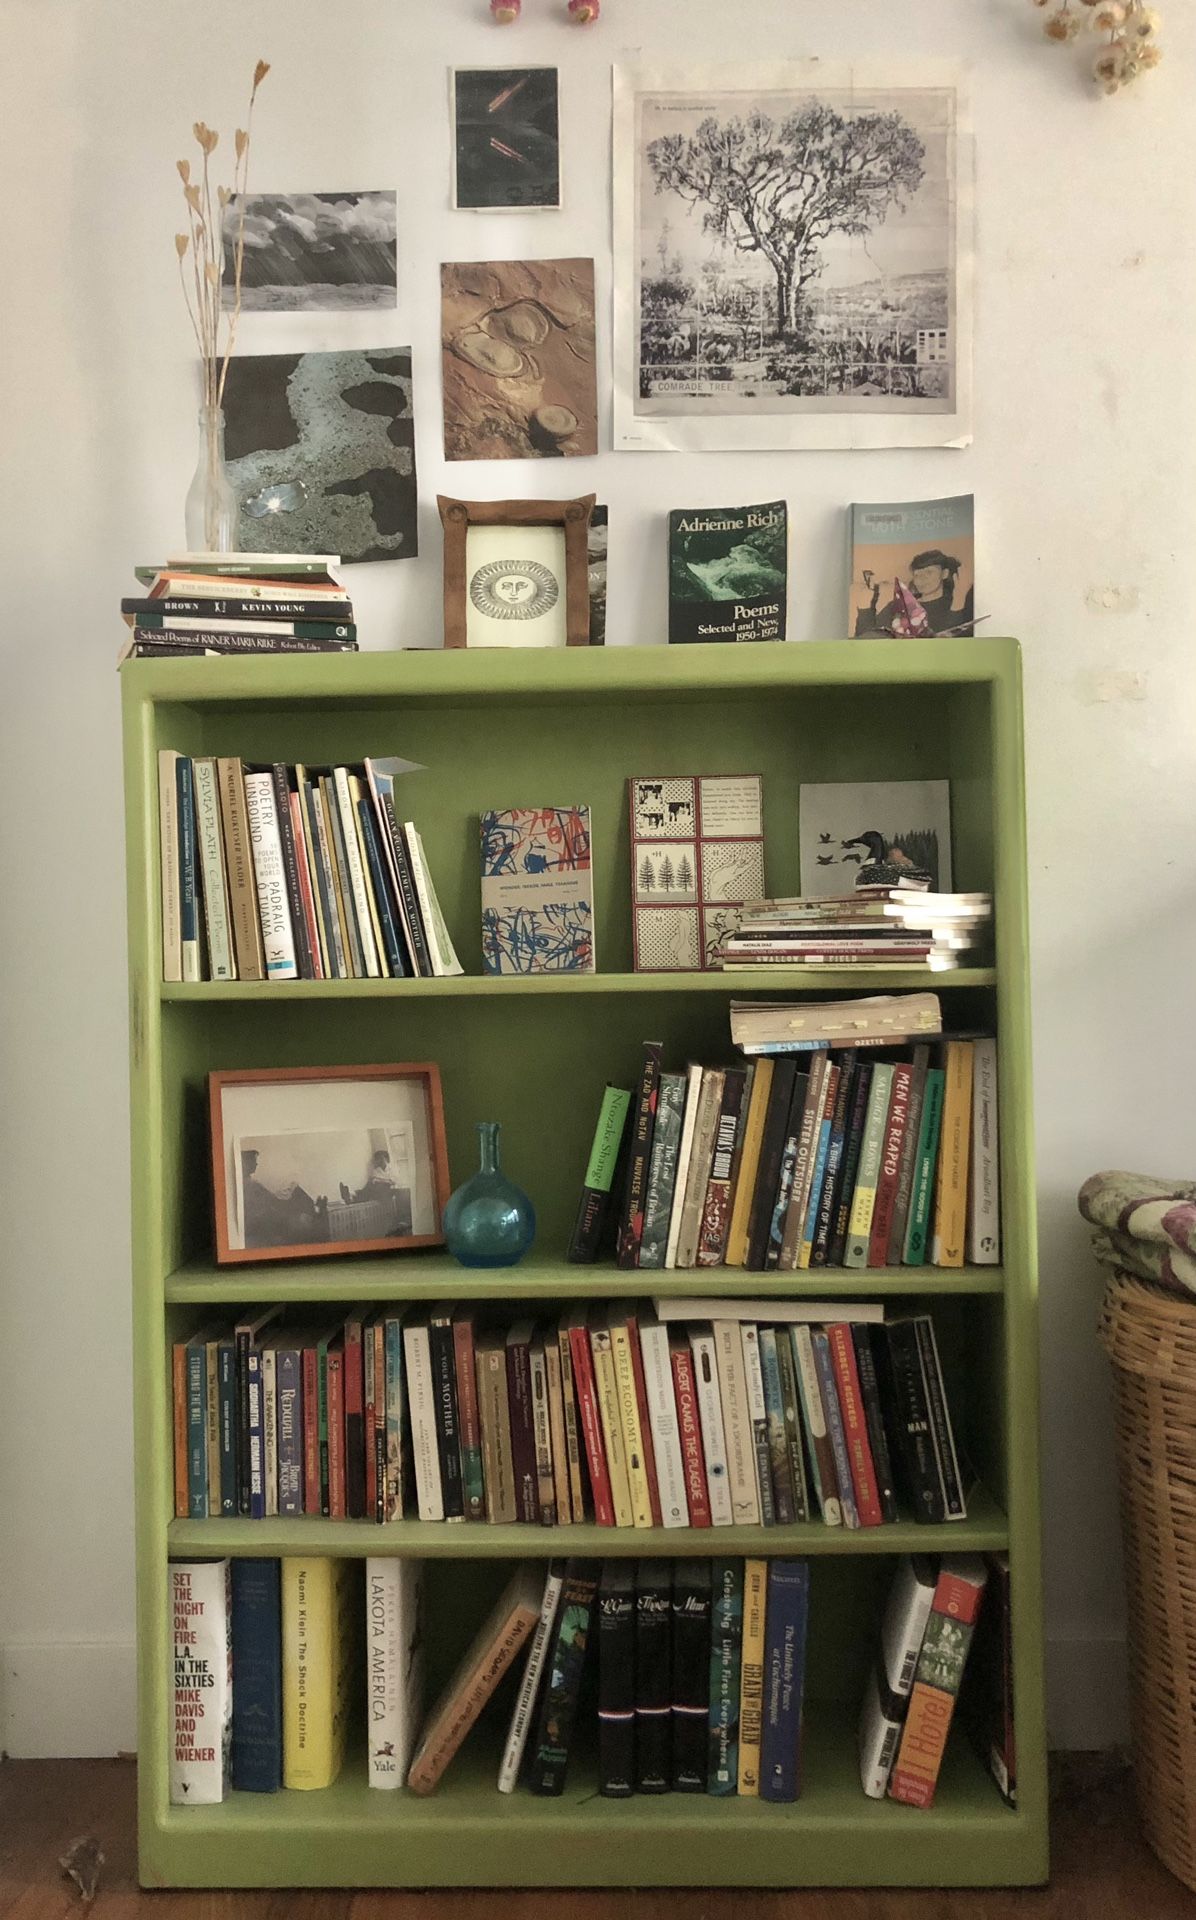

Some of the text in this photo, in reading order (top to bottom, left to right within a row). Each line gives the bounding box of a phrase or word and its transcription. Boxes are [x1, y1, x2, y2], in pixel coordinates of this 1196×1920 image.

[658, 383, 732, 391] COMRADE TREE
[677, 511, 777, 532] Adrienne Rich
[912, 517, 954, 529] STONE
[165, 602, 199, 610] BROWN
[242, 603, 305, 613] KEVIN YOUNG
[734, 603, 779, 620] Poems
[698, 621, 754, 634] Selected and
[140, 631, 167, 642] Selected
[201, 635, 231, 647] RAINER
[232, 637, 256, 648] MARIA
[257, 638, 276, 649] RILKE
[227, 775, 235, 807] MURIEL
[275, 767, 288, 813] GARY SOTO
[200, 767, 217, 860] SYLVIA PLATH
[246, 782, 262, 843] UNBOUND
[258, 781, 273, 826] POETRY
[228, 810, 241, 852] RUKEYSER
[386, 803, 404, 864] OCEAN VUONG
[235, 856, 244, 888] READER
[400, 870, 410, 889] TIME
[209, 870, 220, 917] Collected
[287, 858, 296, 890] SELECTED
[293, 894, 301, 916] POEMS
[406, 894, 413, 902] IS
[260, 895, 272, 938] TUAMA
[409, 913, 421, 948] MOTHER
[644, 1061, 653, 1074] THE
[982, 1056, 990, 1069] The
[642, 1080, 652, 1093] ZAD
[982, 1071, 991, 1087] End
[640, 1098, 650, 1112] AND
[671, 1087, 681, 1103] Guy
[982, 1090, 991, 1098] of
[658, 1086, 670, 1127] Shrubsole
[884, 1072, 910, 1176] MEN WE REAPED
[593, 1093, 624, 1185] Ntozake Shange
[713, 1115, 736, 1178] OCTAVIA'S BROOD
[662, 1144, 674, 1180] The Lost
[792, 1110, 814, 1202] SISTER OUTSIDER
[826, 1150, 837, 1174] BRIEF
[864, 1141, 880, 1176] BONES
[631, 1157, 644, 1195] MAUVAISE
[646, 1143, 664, 1227] Rainforests of Britain
[822, 1176, 835, 1210] HISTORY
[582, 1192, 601, 1233] Liliane
[820, 1212, 828, 1223] OF
[982, 1198, 991, 1214] Roy
[817, 1225, 827, 1244] TIME
[722, 1332, 731, 1354] RICH
[834, 1330, 848, 1382] ELIZABETH
[191, 1394, 200, 1405] THE
[249, 1383, 258, 1427] SIDDHARTHA
[265, 1391, 273, 1402] THE
[618, 1350, 636, 1444] DEEP ECONOMY
[728, 1383, 736, 1405] FACT
[191, 1408, 200, 1424] WALL
[281, 1389, 295, 1441] REDWALL
[442, 1383, 453, 1436] MOTHER
[731, 1408, 738, 1420] OF
[831, 1414, 837, 1424] OF
[676, 1354, 701, 1500] ALBERT CAMUS THE PLAGUE
[251, 1436, 260, 1494] HERMANN HESSE
[280, 1459, 291, 1498] JACQUES
[290, 1465, 301, 1491] BRIAN
[173, 1573, 191, 1586] SET
[299, 1571, 307, 1605] Naomi
[174, 1588, 192, 1600] THE
[720, 1570, 734, 1628] Celeste Ng
[174, 1602, 204, 1615] NIGHT
[174, 1617, 187, 1629] ON
[505, 1620, 526, 1646] DAVID
[175, 1632, 196, 1643] FIRE
[372, 1576, 385, 1721] LAKOTA AMERICA
[175, 1646, 193, 1658] L.A.
[299, 1643, 307, 1660] The
[773, 1649, 780, 1657] at
[175, 1661, 208, 1673] IN THE
[782, 1625, 794, 1711] The Unlikely Peace
[175, 1675, 214, 1687] SIXTIES
[299, 1666, 307, 1697] Shock
[514, 1623, 548, 1738] BUILDING THE NEW AMERICAN ECONOMY
[175, 1689, 200, 1702] MIKE
[718, 1639, 732, 1764] Little Fires Everywhere
[742, 1664, 763, 1745] GRAIN GRAIN
[175, 1704, 204, 1717] DAVIS
[908, 1690, 953, 1755] Hotel
[175, 1719, 196, 1731] AND
[299, 1703, 307, 1749] Doctrine
[176, 1734, 194, 1746] JON
[176, 1748, 214, 1761] WIENER
[374, 1761, 396, 1771] Yale
